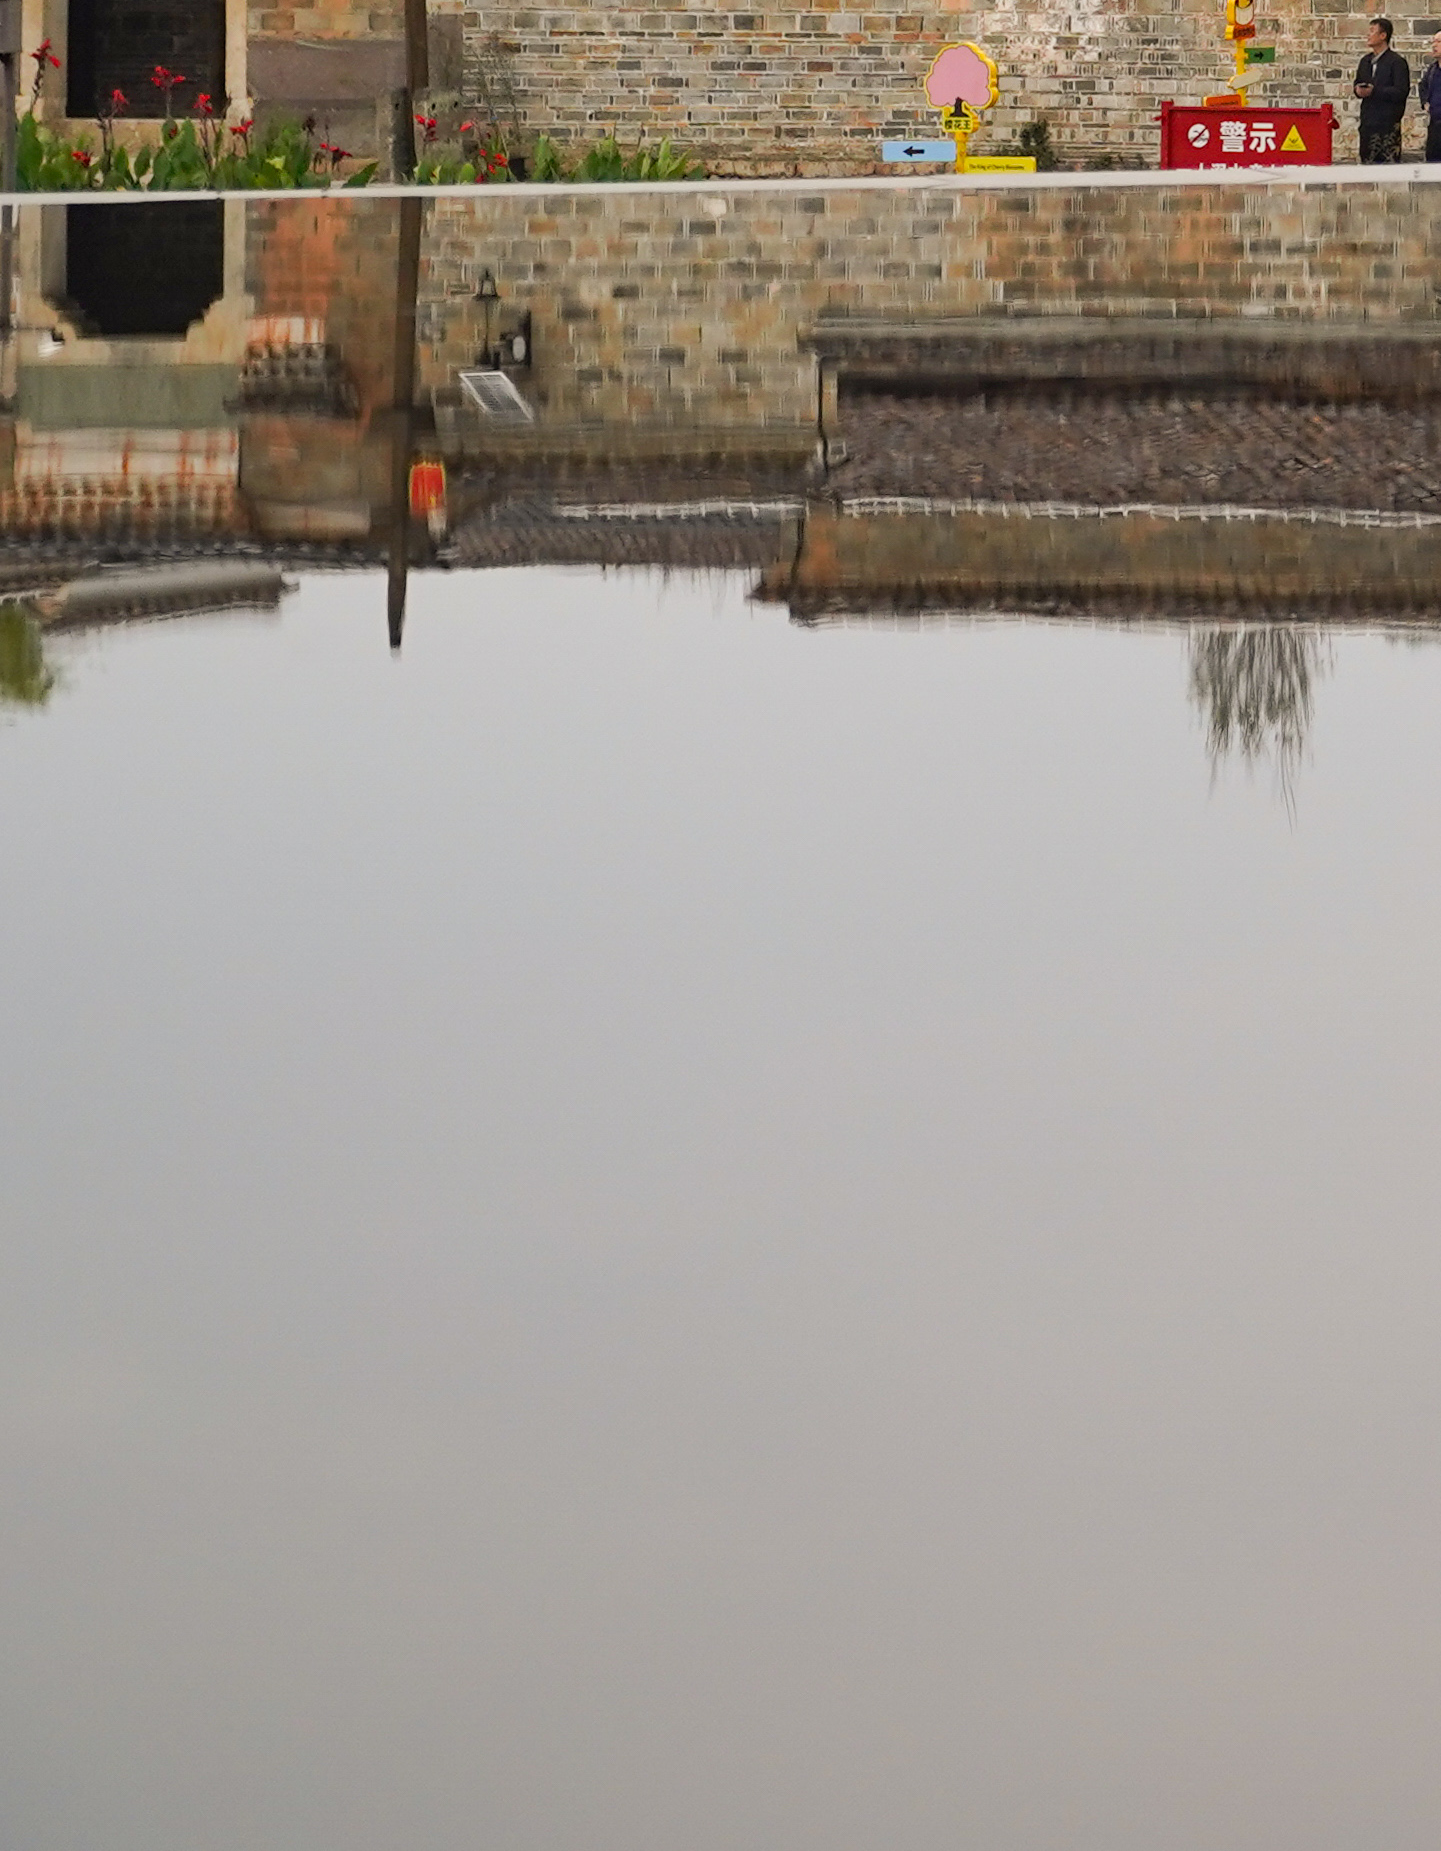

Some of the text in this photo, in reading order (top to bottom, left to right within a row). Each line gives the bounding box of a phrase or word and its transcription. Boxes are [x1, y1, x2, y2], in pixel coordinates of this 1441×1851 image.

[945, 119, 971, 130] 樱花王
[1219, 121, 1276, 153] 警示
